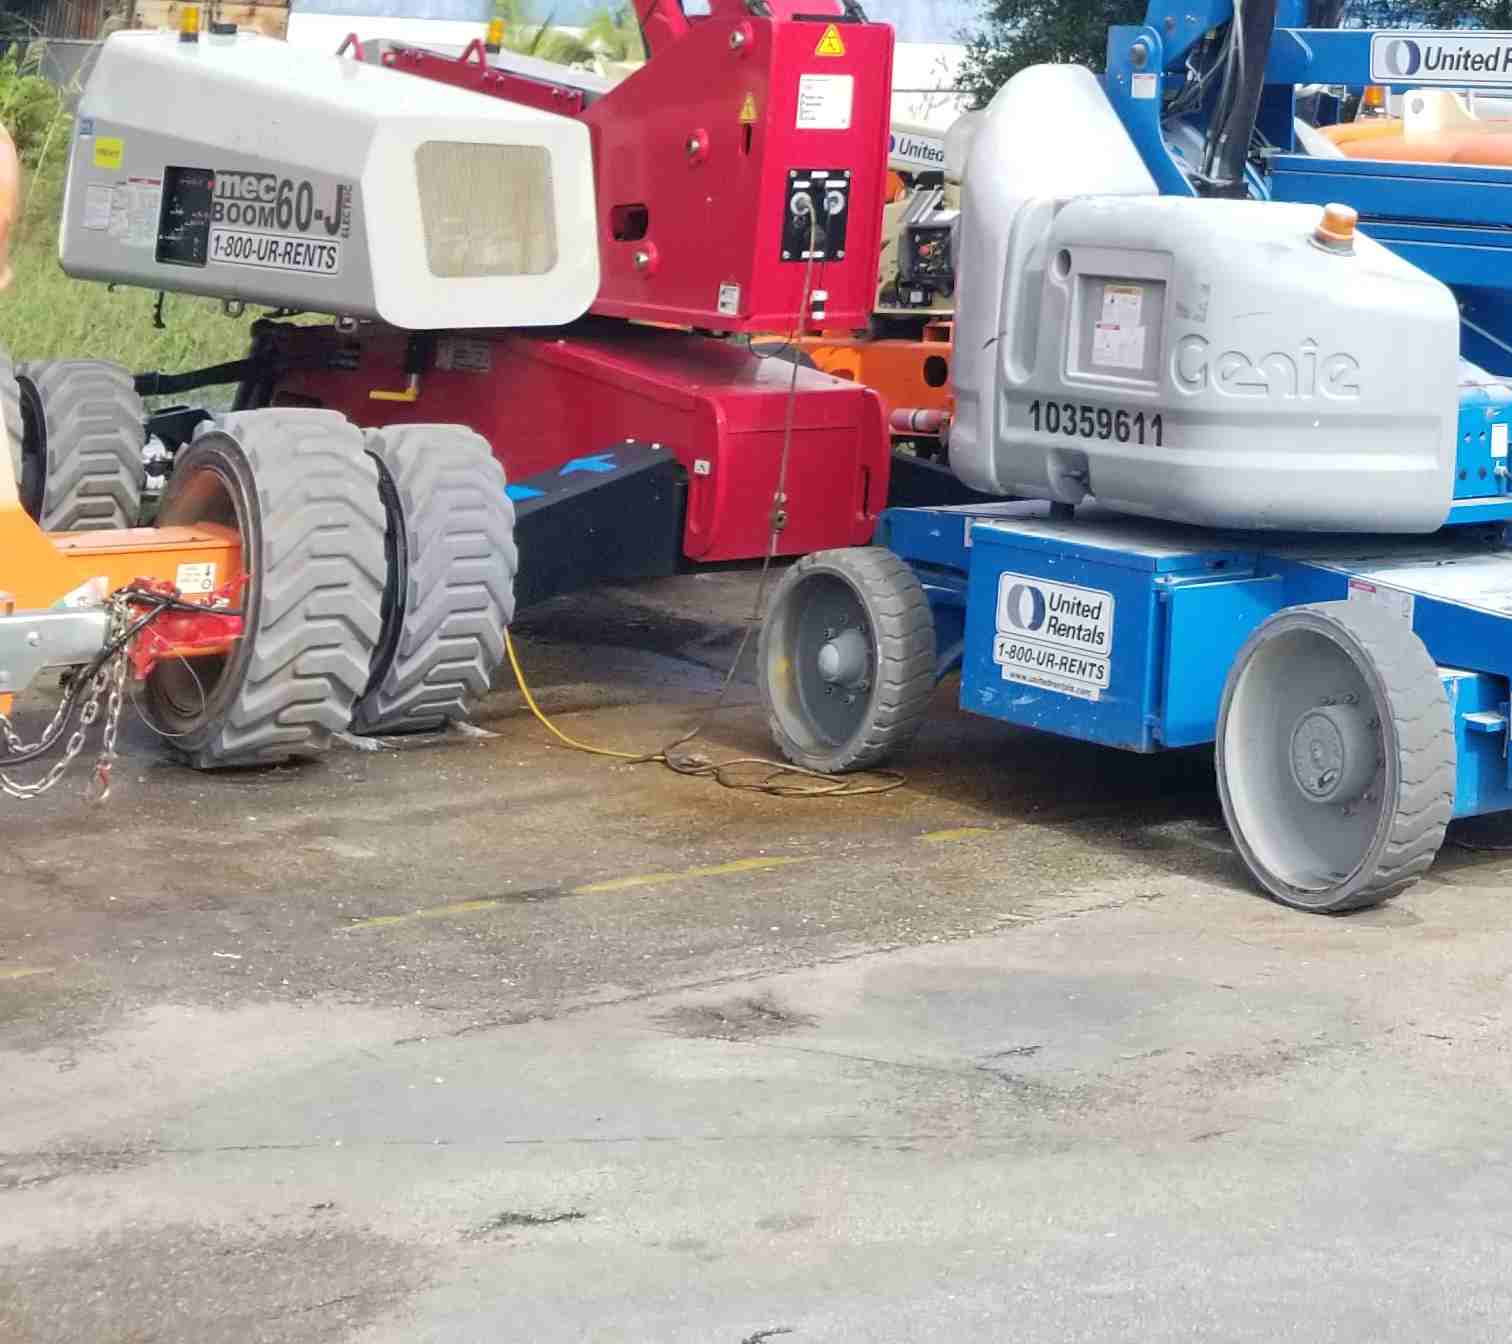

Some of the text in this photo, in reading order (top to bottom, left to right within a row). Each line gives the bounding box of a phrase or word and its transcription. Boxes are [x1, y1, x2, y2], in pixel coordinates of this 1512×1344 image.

[1424, 46, 1501, 72] United
[211, 201, 276, 229] BOOM
[213, 233, 337, 270] 1-800-UR-RENTS
[1170, 332, 1361, 400] Genie
[1029, 399, 1163, 447] 10359611
[1048, 592, 1103, 620] United
[1046, 615, 1105, 645] Rentals
[998, 643, 1105, 680] 1-800-UR-RENTS
